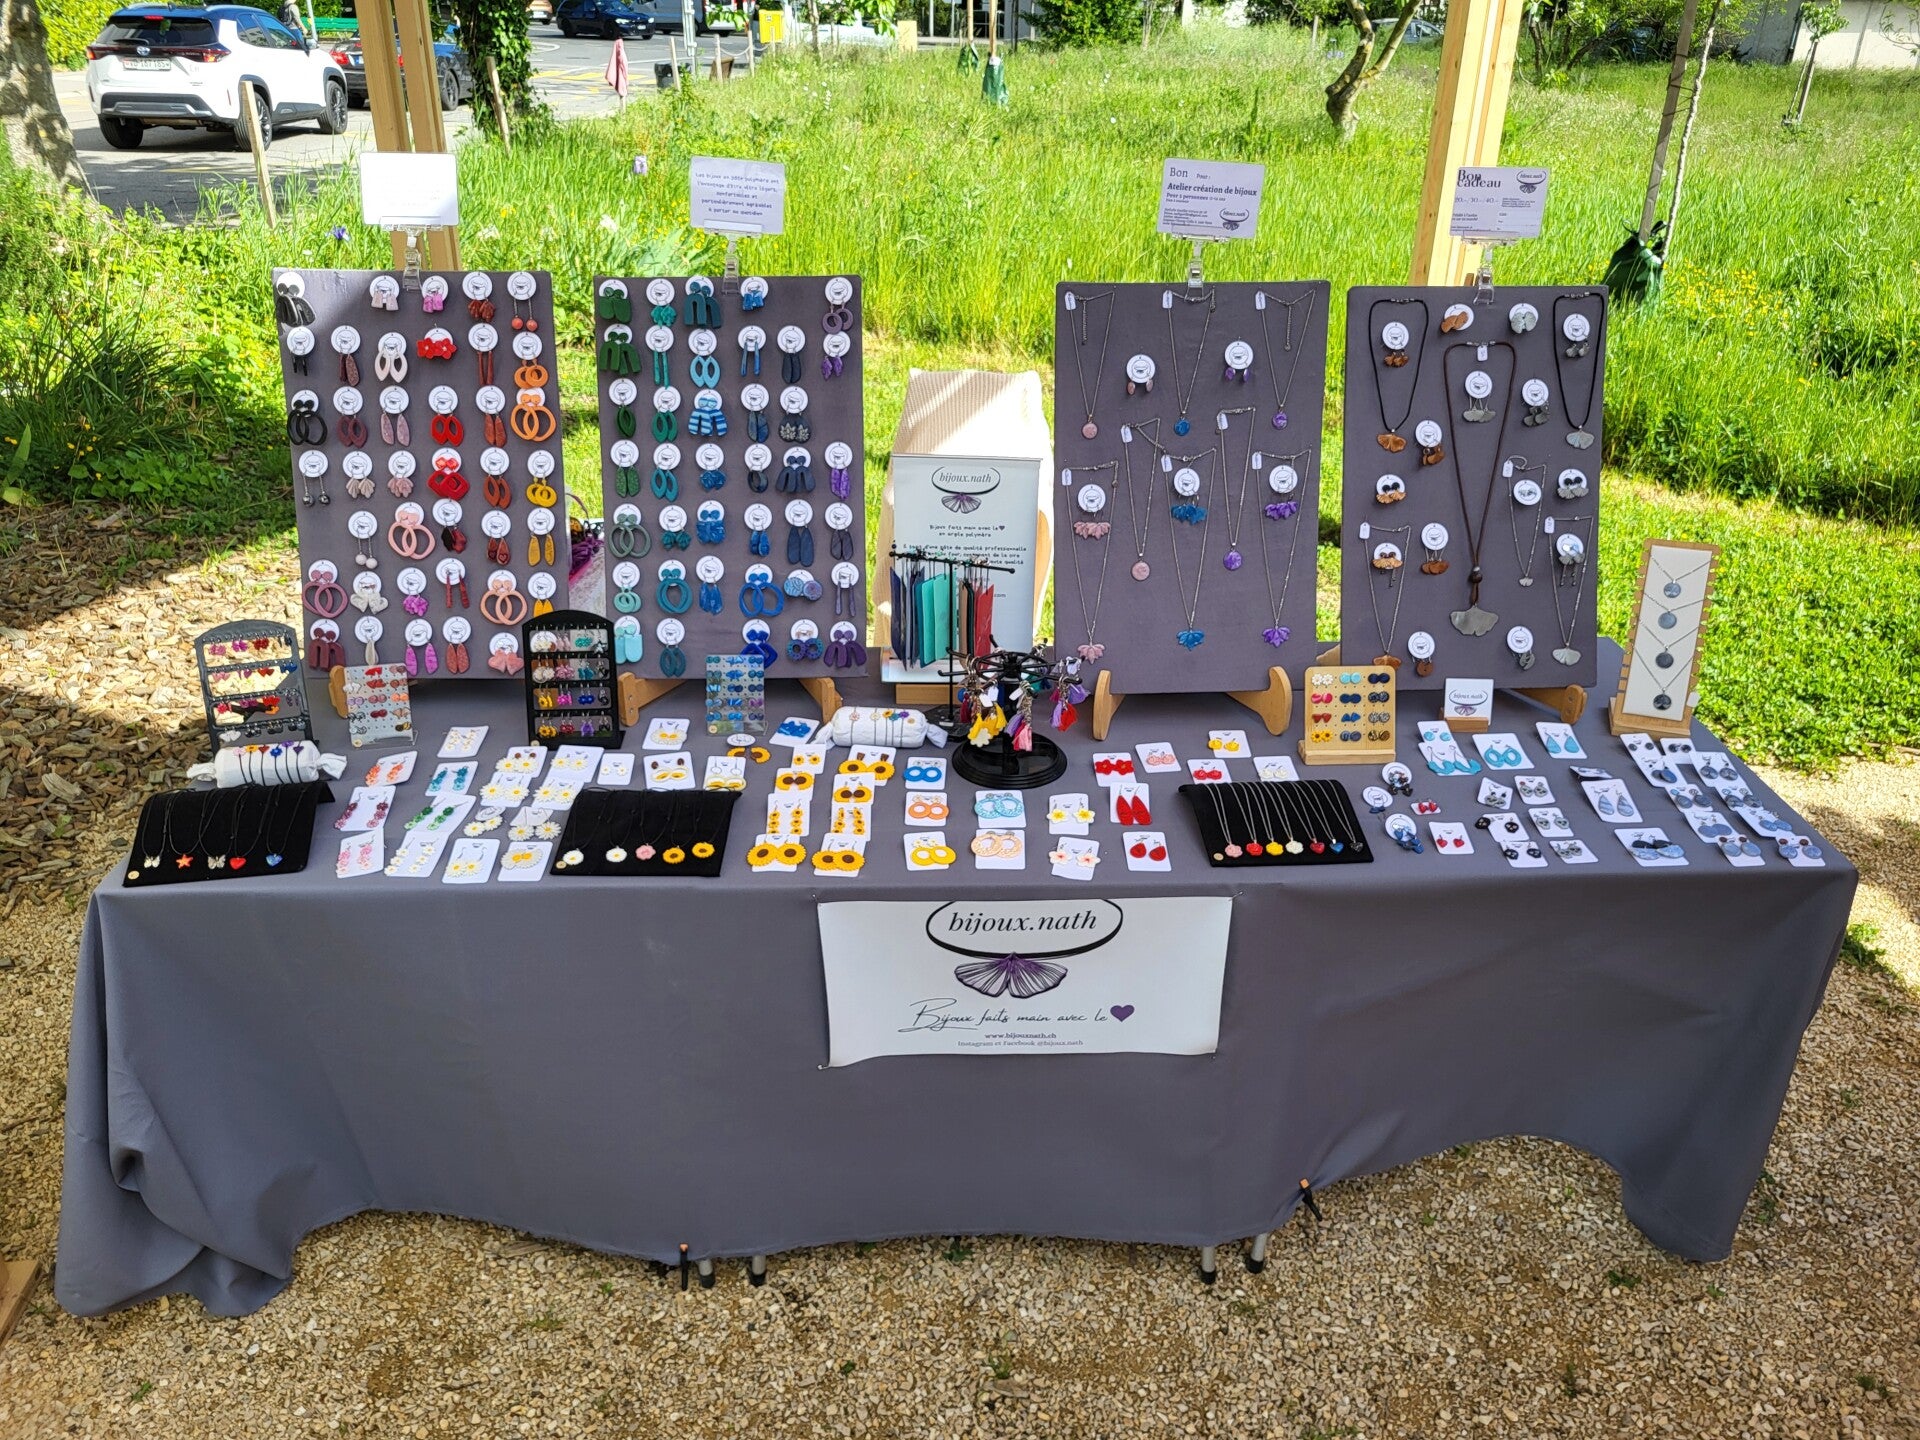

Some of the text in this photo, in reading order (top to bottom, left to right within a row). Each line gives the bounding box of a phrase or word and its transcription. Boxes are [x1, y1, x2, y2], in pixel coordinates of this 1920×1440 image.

[1169, 167, 1189, 178] Bon
[1458, 169, 1482, 181] Bon
[1457, 178, 1502, 188] cadeau
[1167, 182, 1258, 197] Atelier création de bijoux
[939, 472, 992, 484] bijoux.nath
[949, 910, 1097, 935] bijoux.nath
[899, 998, 1109, 1032] Bijoux faits main avec le
[985, 1032, 1057, 1040] www.bijouxnath.ch
[958, 1040, 994, 1048] Instagram
